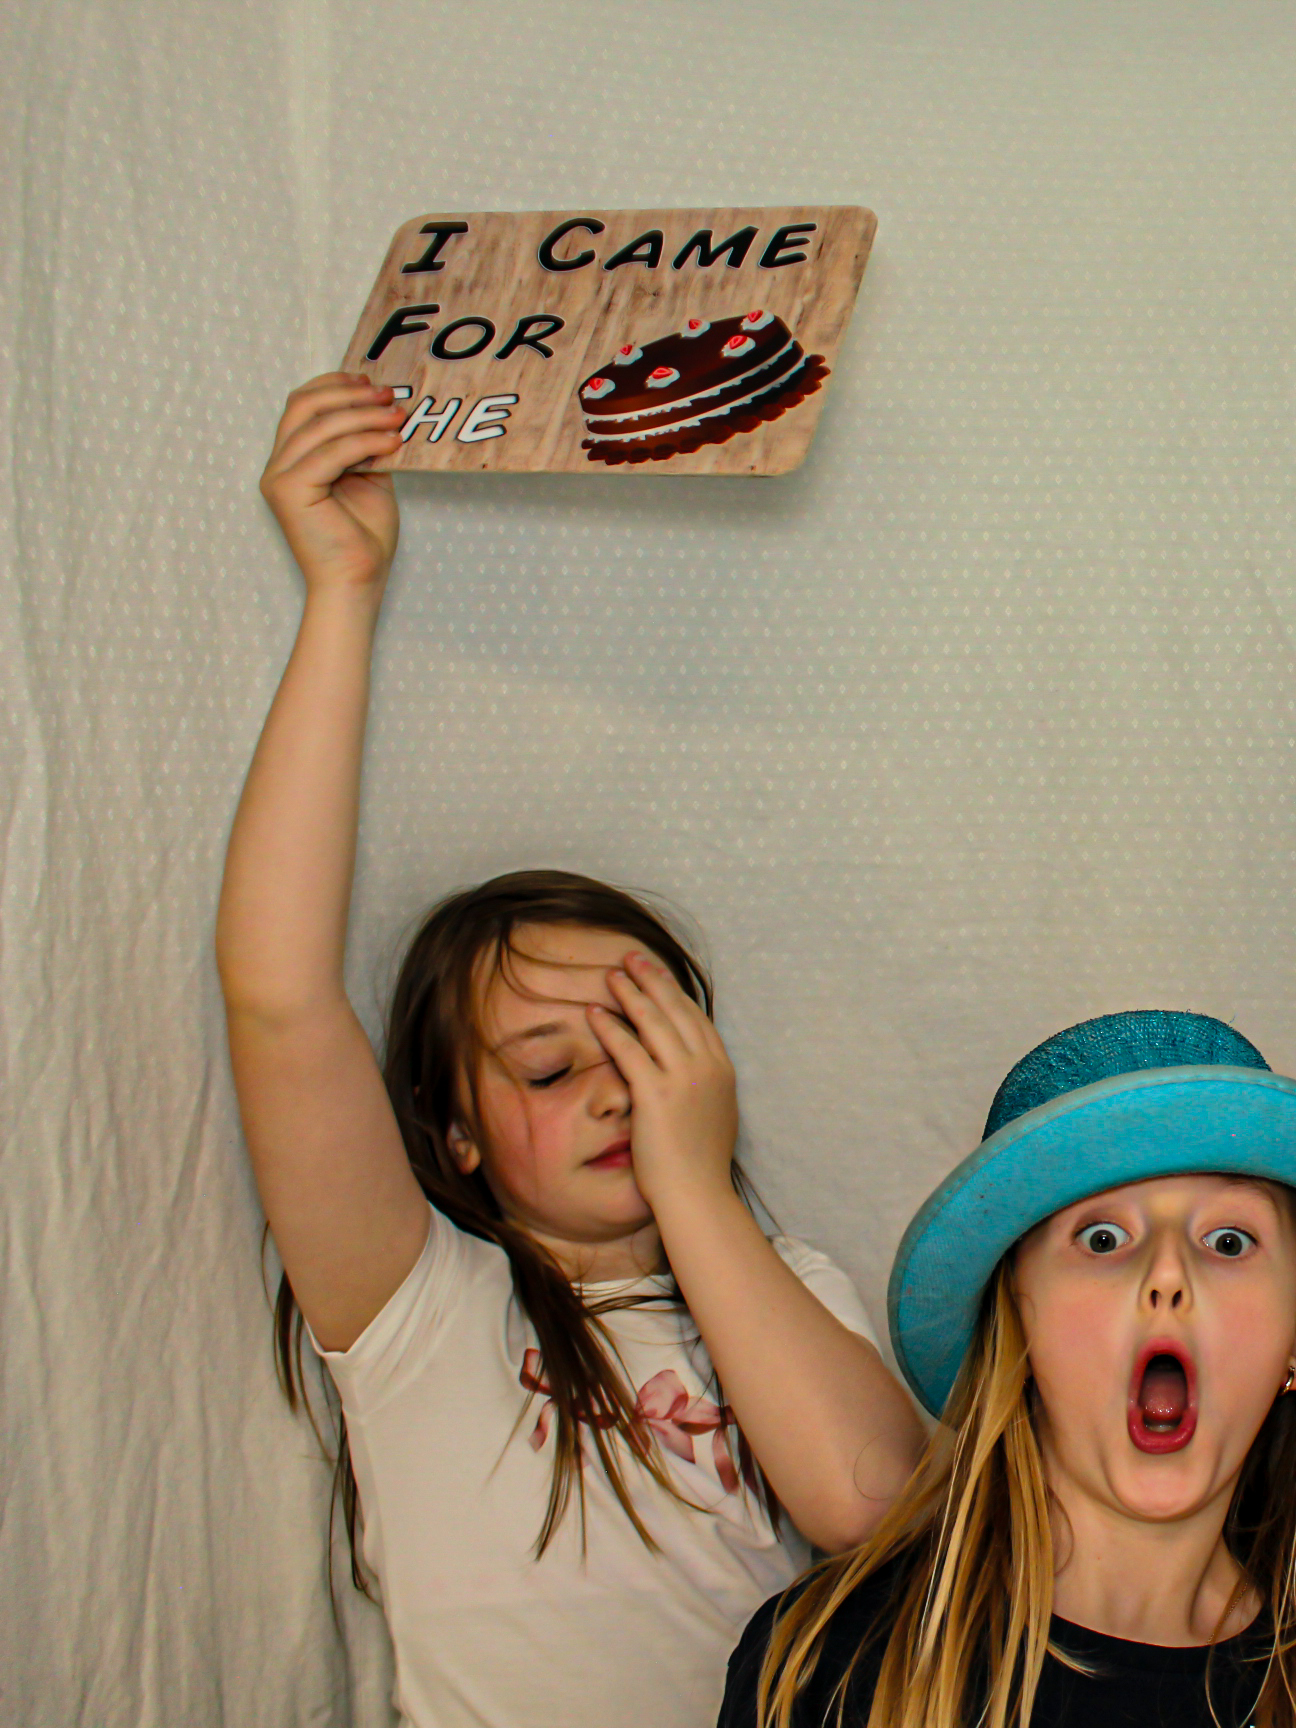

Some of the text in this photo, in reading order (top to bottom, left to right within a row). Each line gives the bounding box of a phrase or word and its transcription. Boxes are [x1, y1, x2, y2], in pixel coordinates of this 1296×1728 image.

[401, 217, 818, 274] I CAME
[365, 303, 566, 361] FOR
[391, 385, 520, 443] HE
